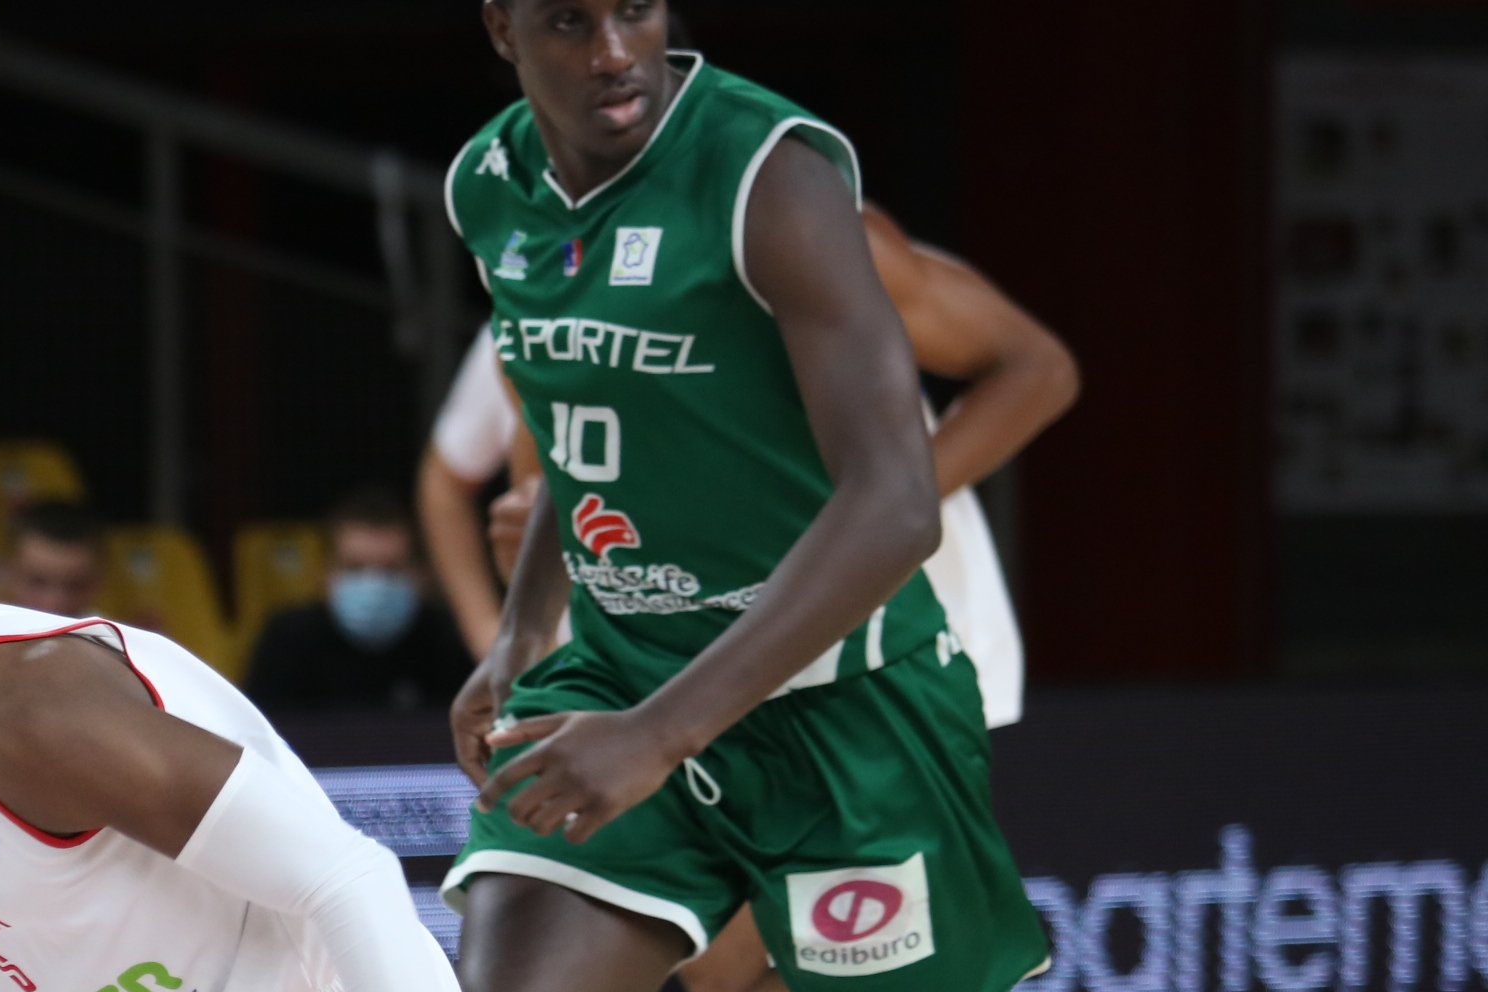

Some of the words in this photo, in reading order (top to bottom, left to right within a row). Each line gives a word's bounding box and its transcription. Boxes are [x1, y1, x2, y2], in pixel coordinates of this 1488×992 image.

[519, 317, 715, 374] PORTEL
[549, 402, 621, 482] 10
[800, 931, 921, 965] ediburo
